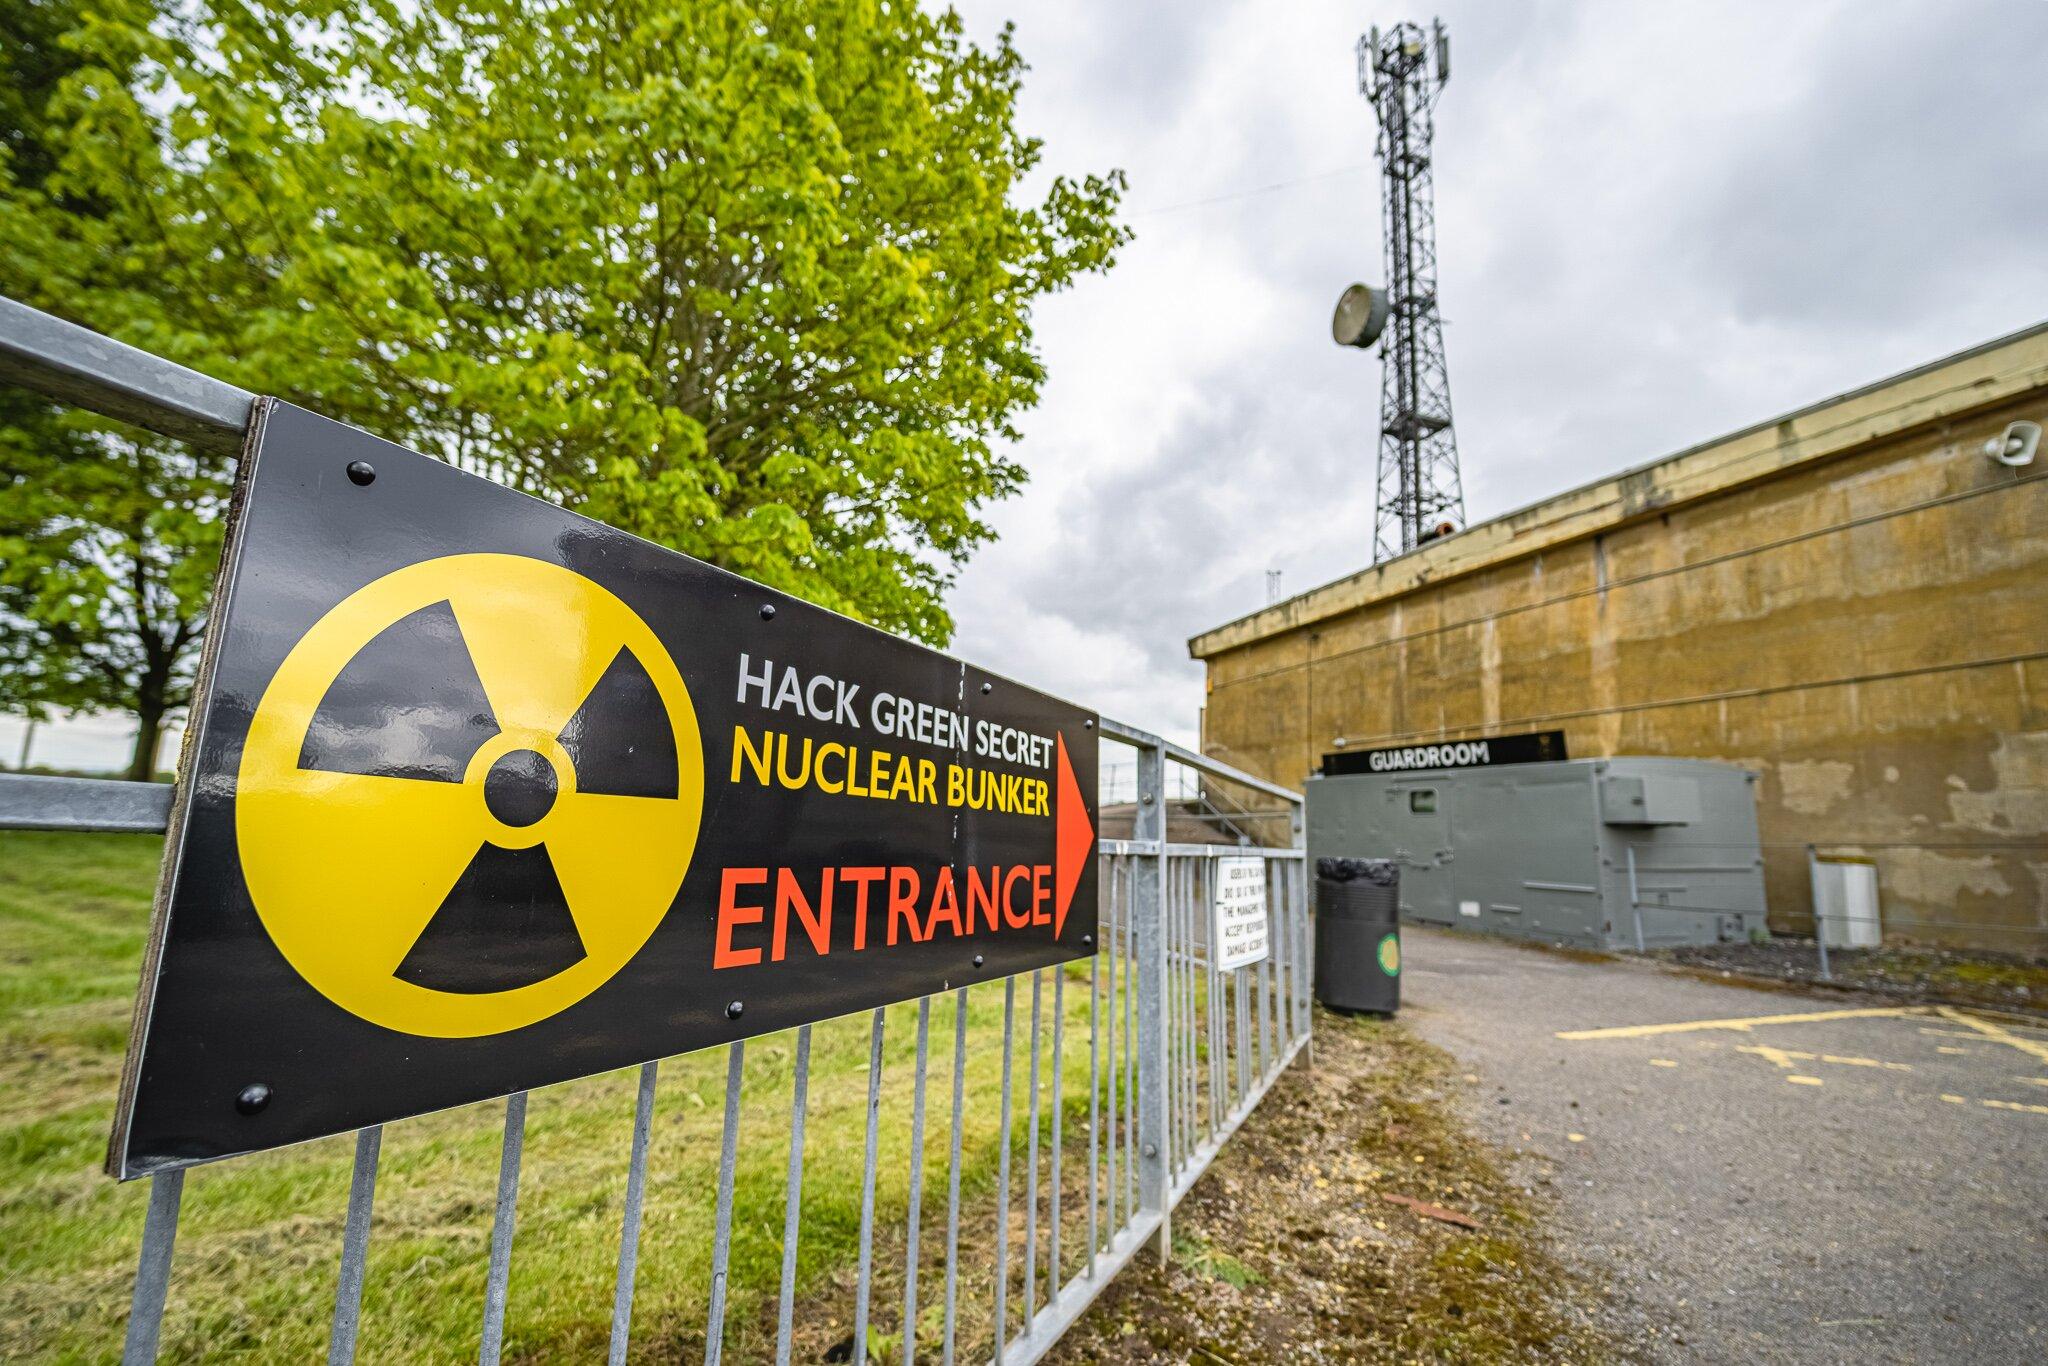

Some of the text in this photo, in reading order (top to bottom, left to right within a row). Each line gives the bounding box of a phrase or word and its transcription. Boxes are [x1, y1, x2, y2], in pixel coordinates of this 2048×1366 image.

[736, 652, 1054, 770] HACK GREEN SECRET
[1369, 741, 1490, 772] GUARDROOM
[730, 725, 1050, 817] NUCLEAR BUNKER
[713, 864, 1052, 970] ENTRANCE
